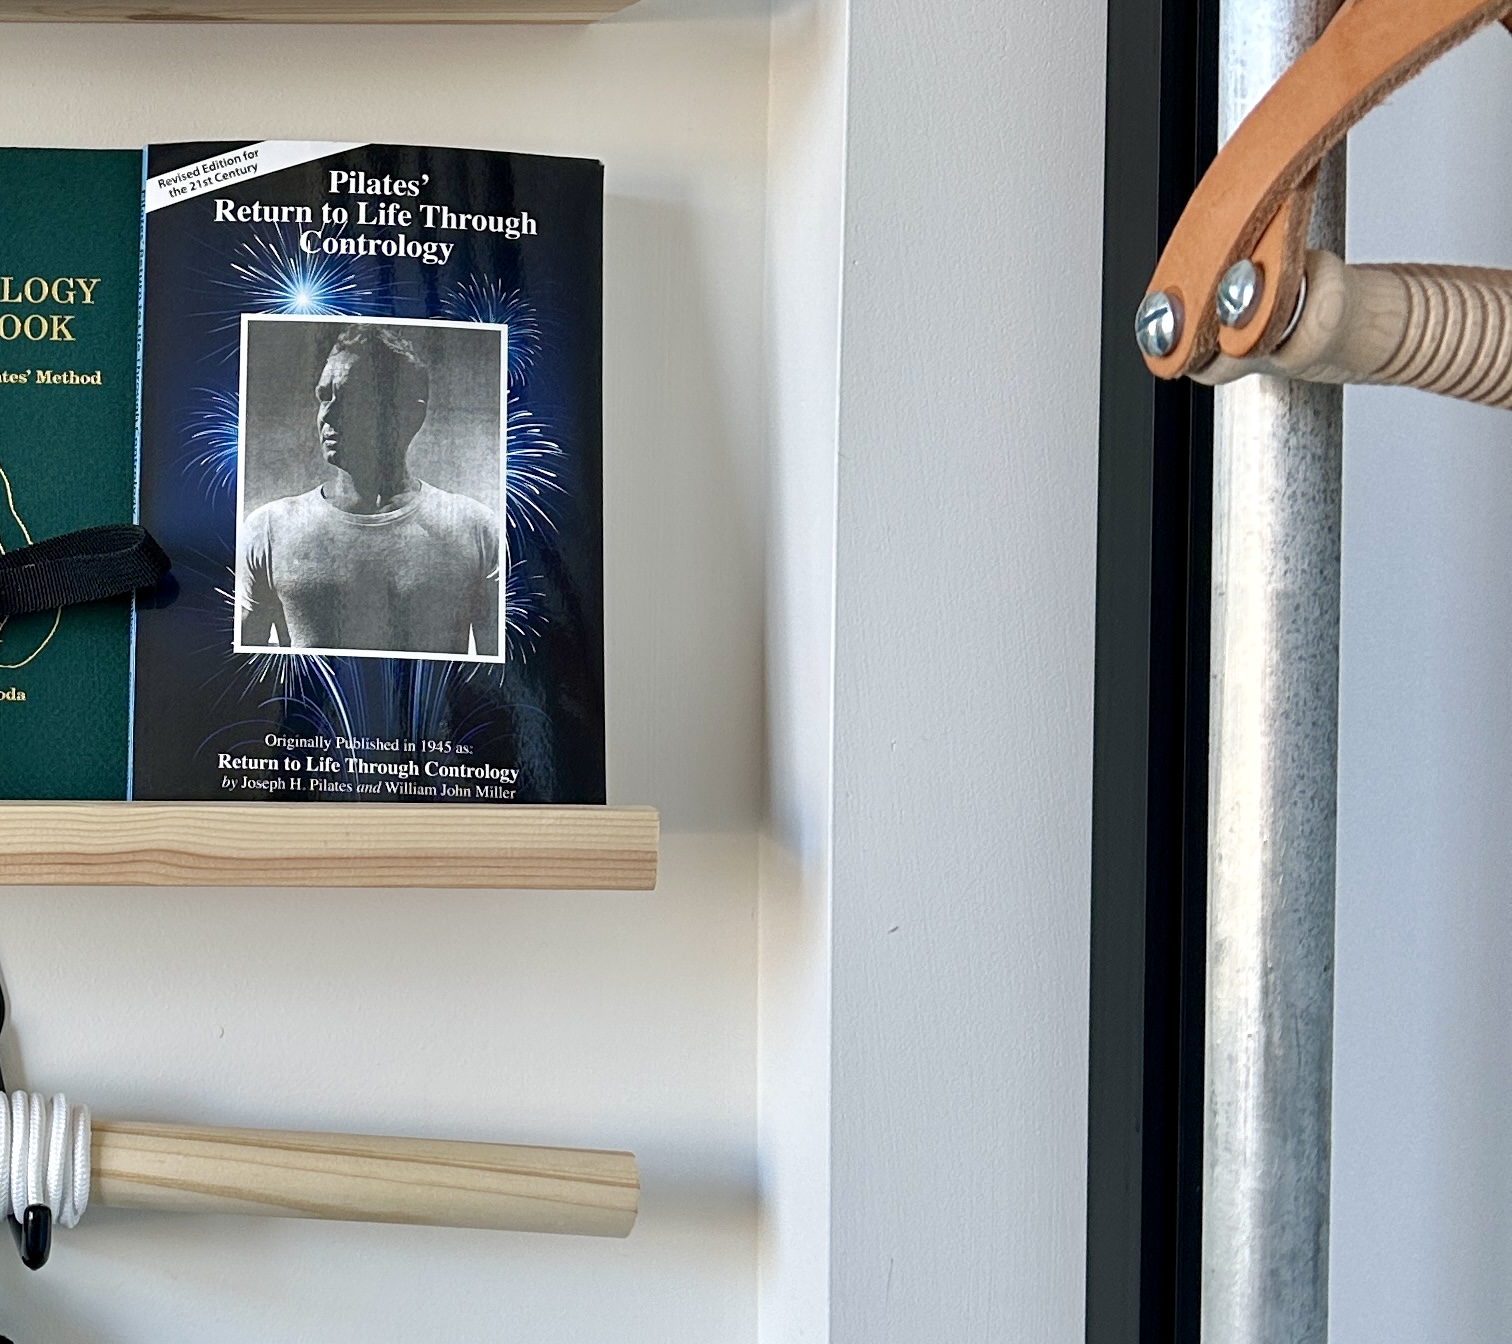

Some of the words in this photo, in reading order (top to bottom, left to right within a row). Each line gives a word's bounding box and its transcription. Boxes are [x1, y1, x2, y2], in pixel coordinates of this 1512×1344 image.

[158, 166, 200, 189] Revised
[202, 156, 241, 175] Edition
[243, 149, 259, 161] for
[169, 186, 188, 198] the
[189, 176, 213, 192] 21st
[214, 163, 258, 182] Century
[328, 169, 430, 197] Pilates’
[214, 198, 313, 225] Return
[322, 200, 349, 225] to
[356, 201, 412, 227] Life
[420, 205, 538, 240] Through
[299, 230, 454, 265] Contrology
[35, 370, 102, 385] Method
[264, 733, 331, 752] Originally
[335, 736, 399, 752] Published
[403, 738, 416, 752] in
[421, 740, 452, 753] 1945
[455, 744, 474, 754] as:
[218, 753, 279, 770] Return
[284, 756, 301, 771] to
[306, 756, 341, 772] Life
[345, 758, 419, 779] Through
[424, 760, 520, 784] Contrology
[221, 775, 239, 791] by
[241, 776, 286, 793] Joseph
[289, 777, 307, 791] H.
[310, 778, 353, 792] Pilates
[356, 780, 382, 794] and
[385, 781, 437, 796] William
[440, 783, 472, 798] John
[475, 785, 517, 799] Miller
